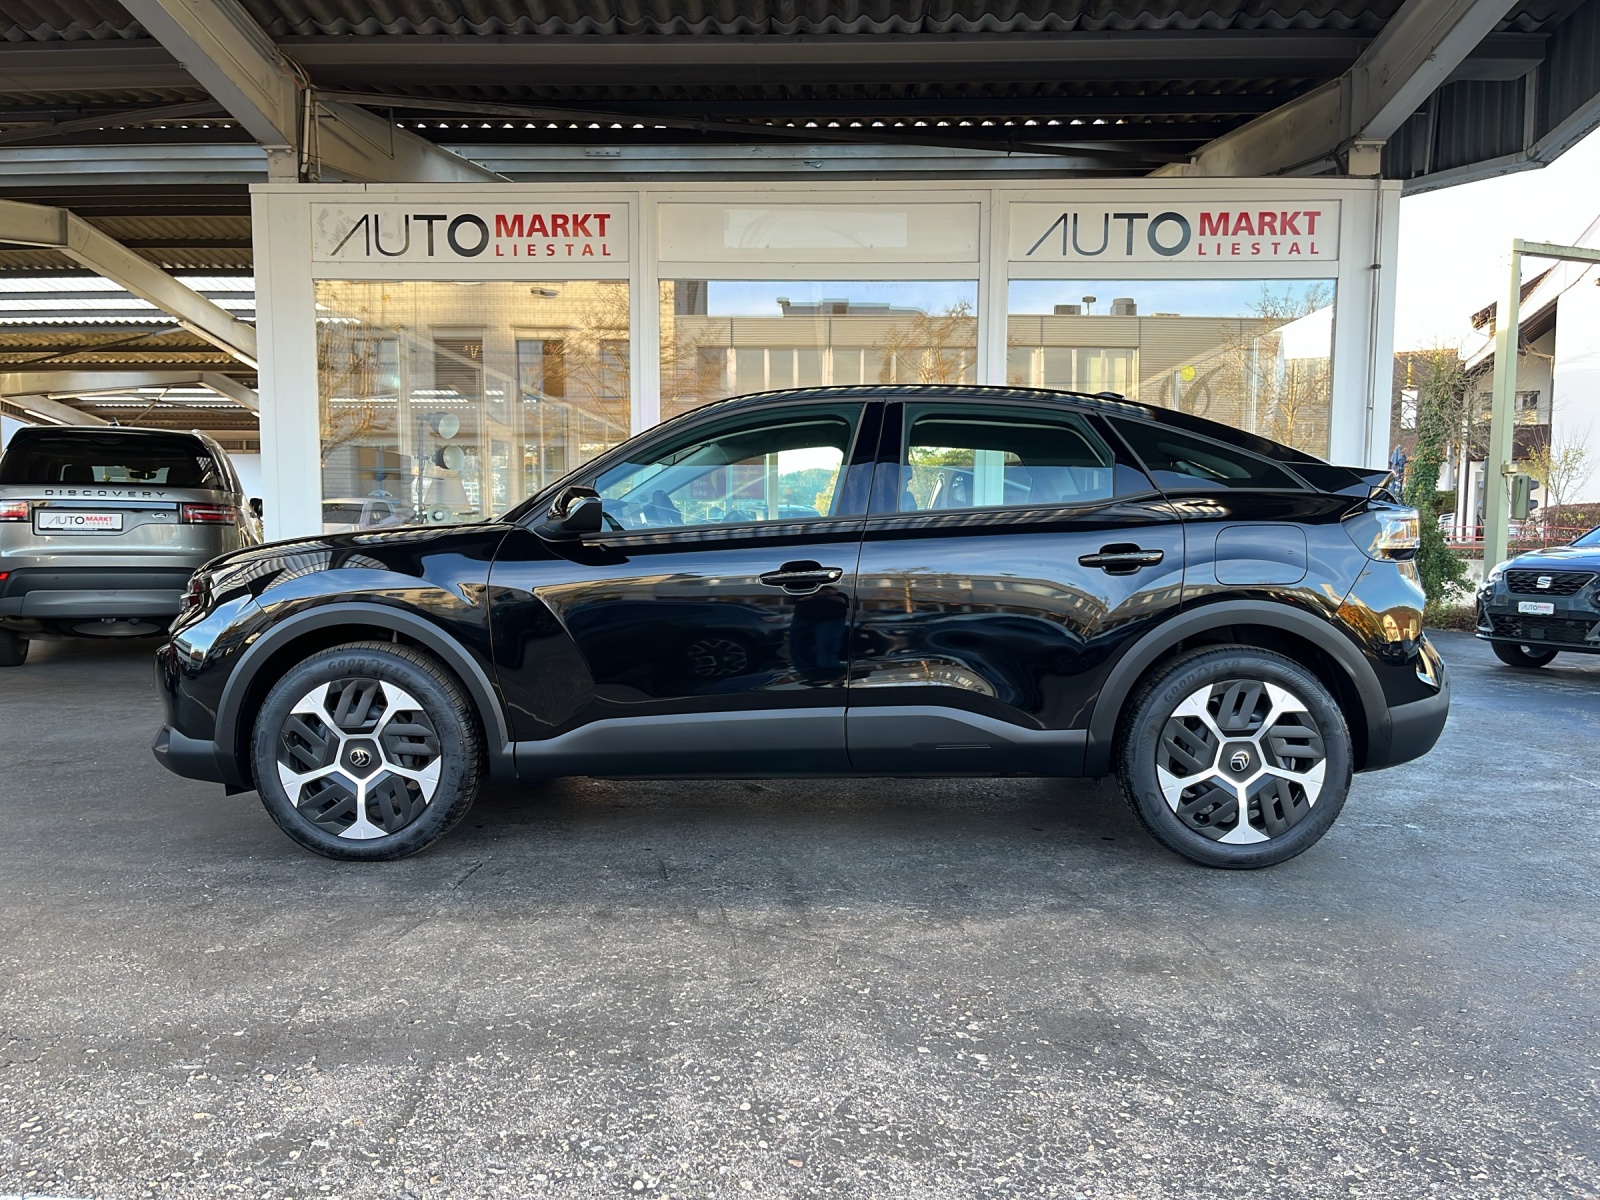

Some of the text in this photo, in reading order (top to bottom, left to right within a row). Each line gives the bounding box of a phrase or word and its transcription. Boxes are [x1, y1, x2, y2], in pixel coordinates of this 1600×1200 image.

[329, 213, 611, 258] AUTO MARKT
[1025, 210, 1321, 257] AUTO MARKT
[495, 243, 611, 257] LIESTAL
[1197, 241, 1320, 256] LIESTAL
[44, 489, 166, 497] DISCOVERY
[48, 515, 85, 525] AUTO
[328, 658, 411, 679] GOODYEAR
[1163, 660, 1241, 703] GOODYEAR
